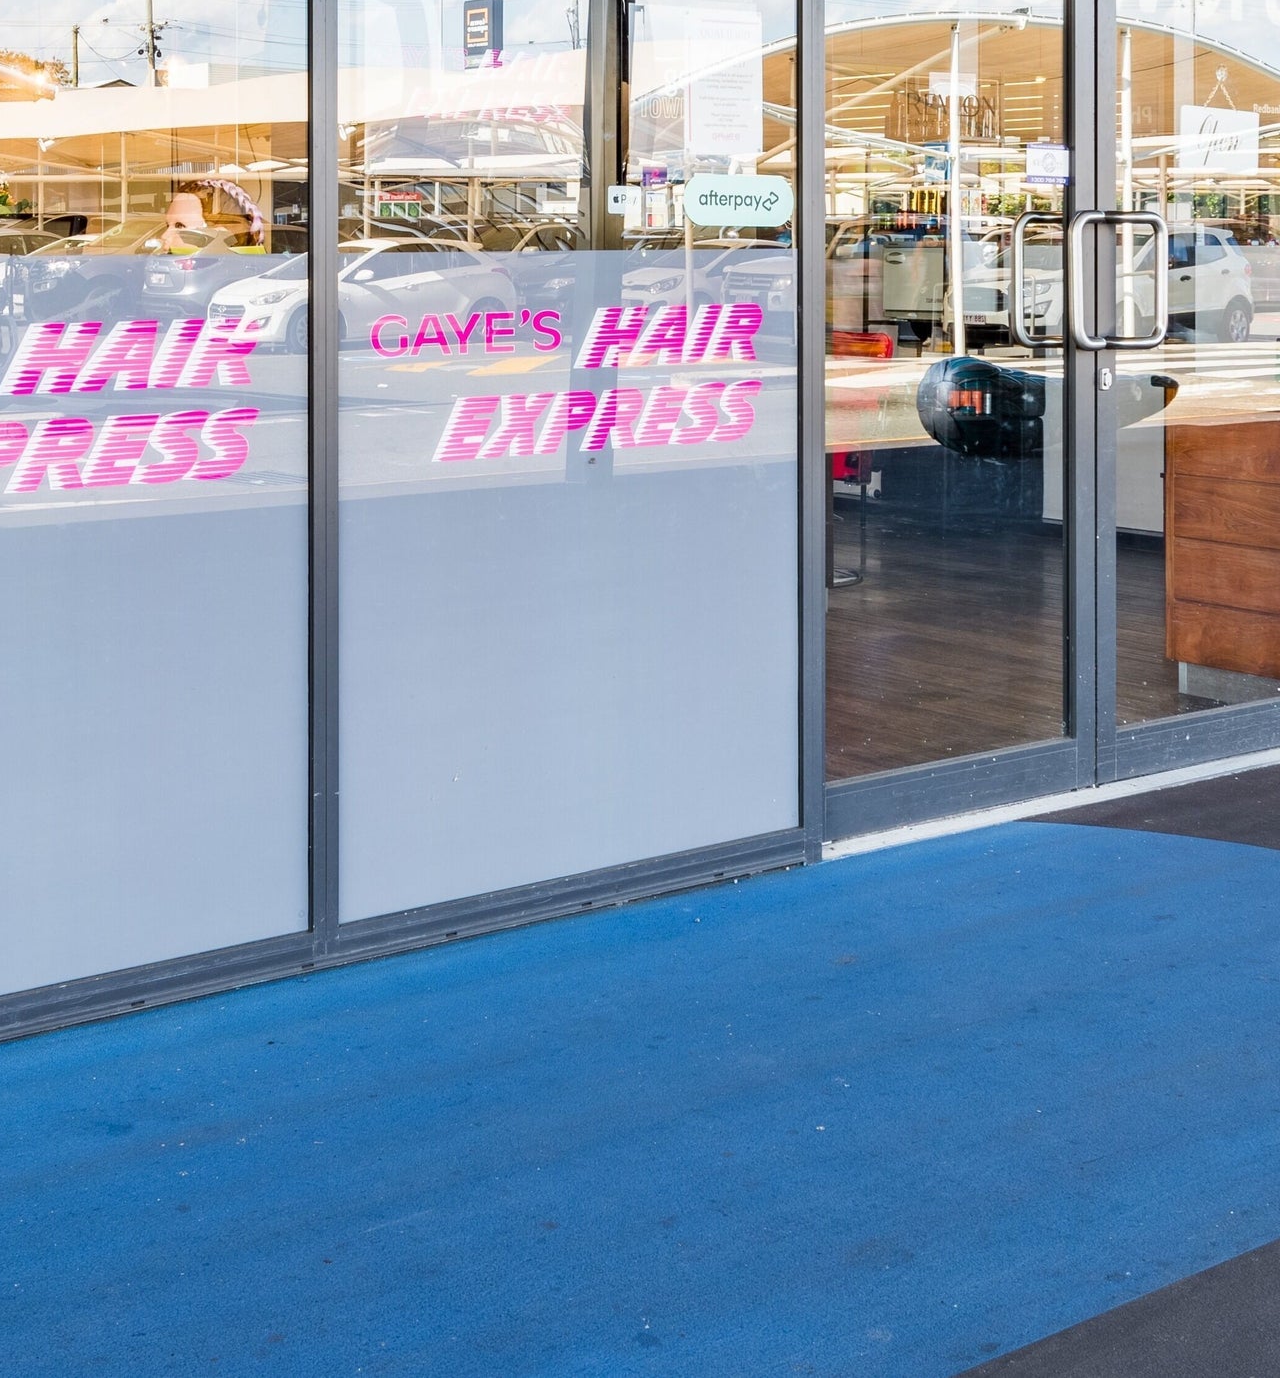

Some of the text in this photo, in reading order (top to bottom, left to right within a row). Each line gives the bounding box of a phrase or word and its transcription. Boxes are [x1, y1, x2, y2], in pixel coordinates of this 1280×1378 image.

[907, 93, 997, 117] REVON
[699, 190, 762, 211] afterpay
[370, 302, 765, 370] GAYE'S HAIR
[430, 378, 764, 463] EXPRESS
